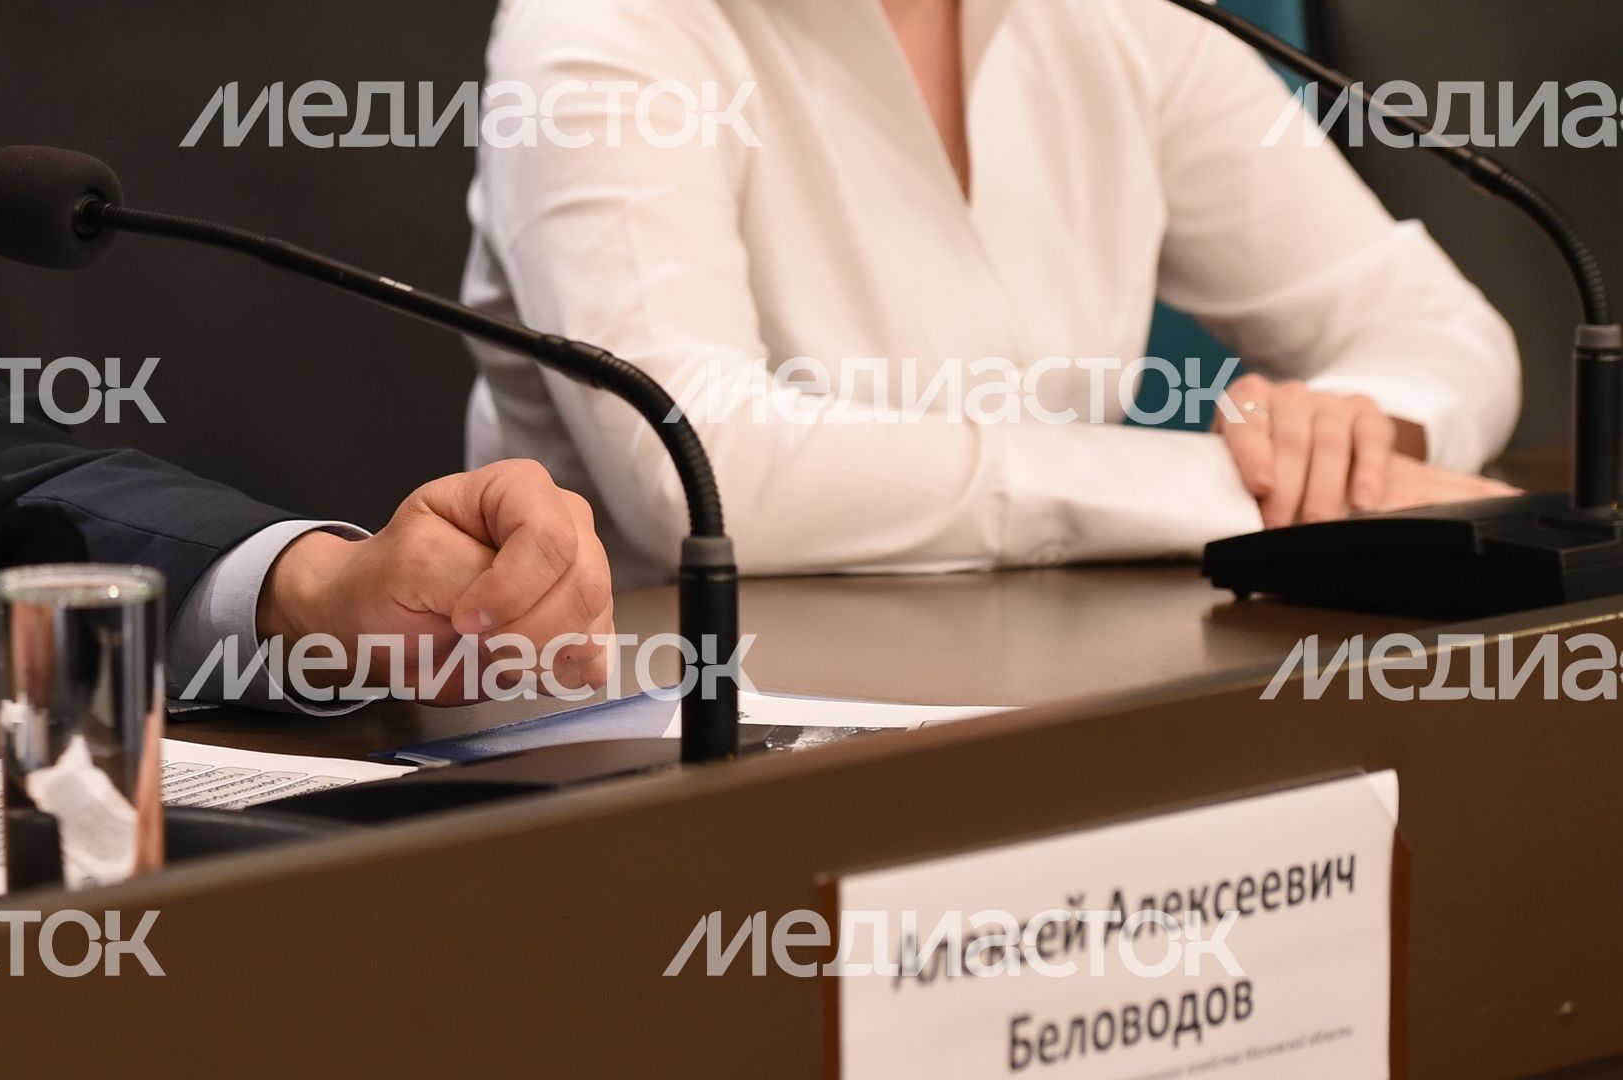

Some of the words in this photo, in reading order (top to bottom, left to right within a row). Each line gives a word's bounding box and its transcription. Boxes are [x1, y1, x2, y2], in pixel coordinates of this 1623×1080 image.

[892, 892, 1087, 992] Алексей
[1101, 853, 1358, 946] Алексеевич
[1006, 978, 1254, 1072] Беловодов
